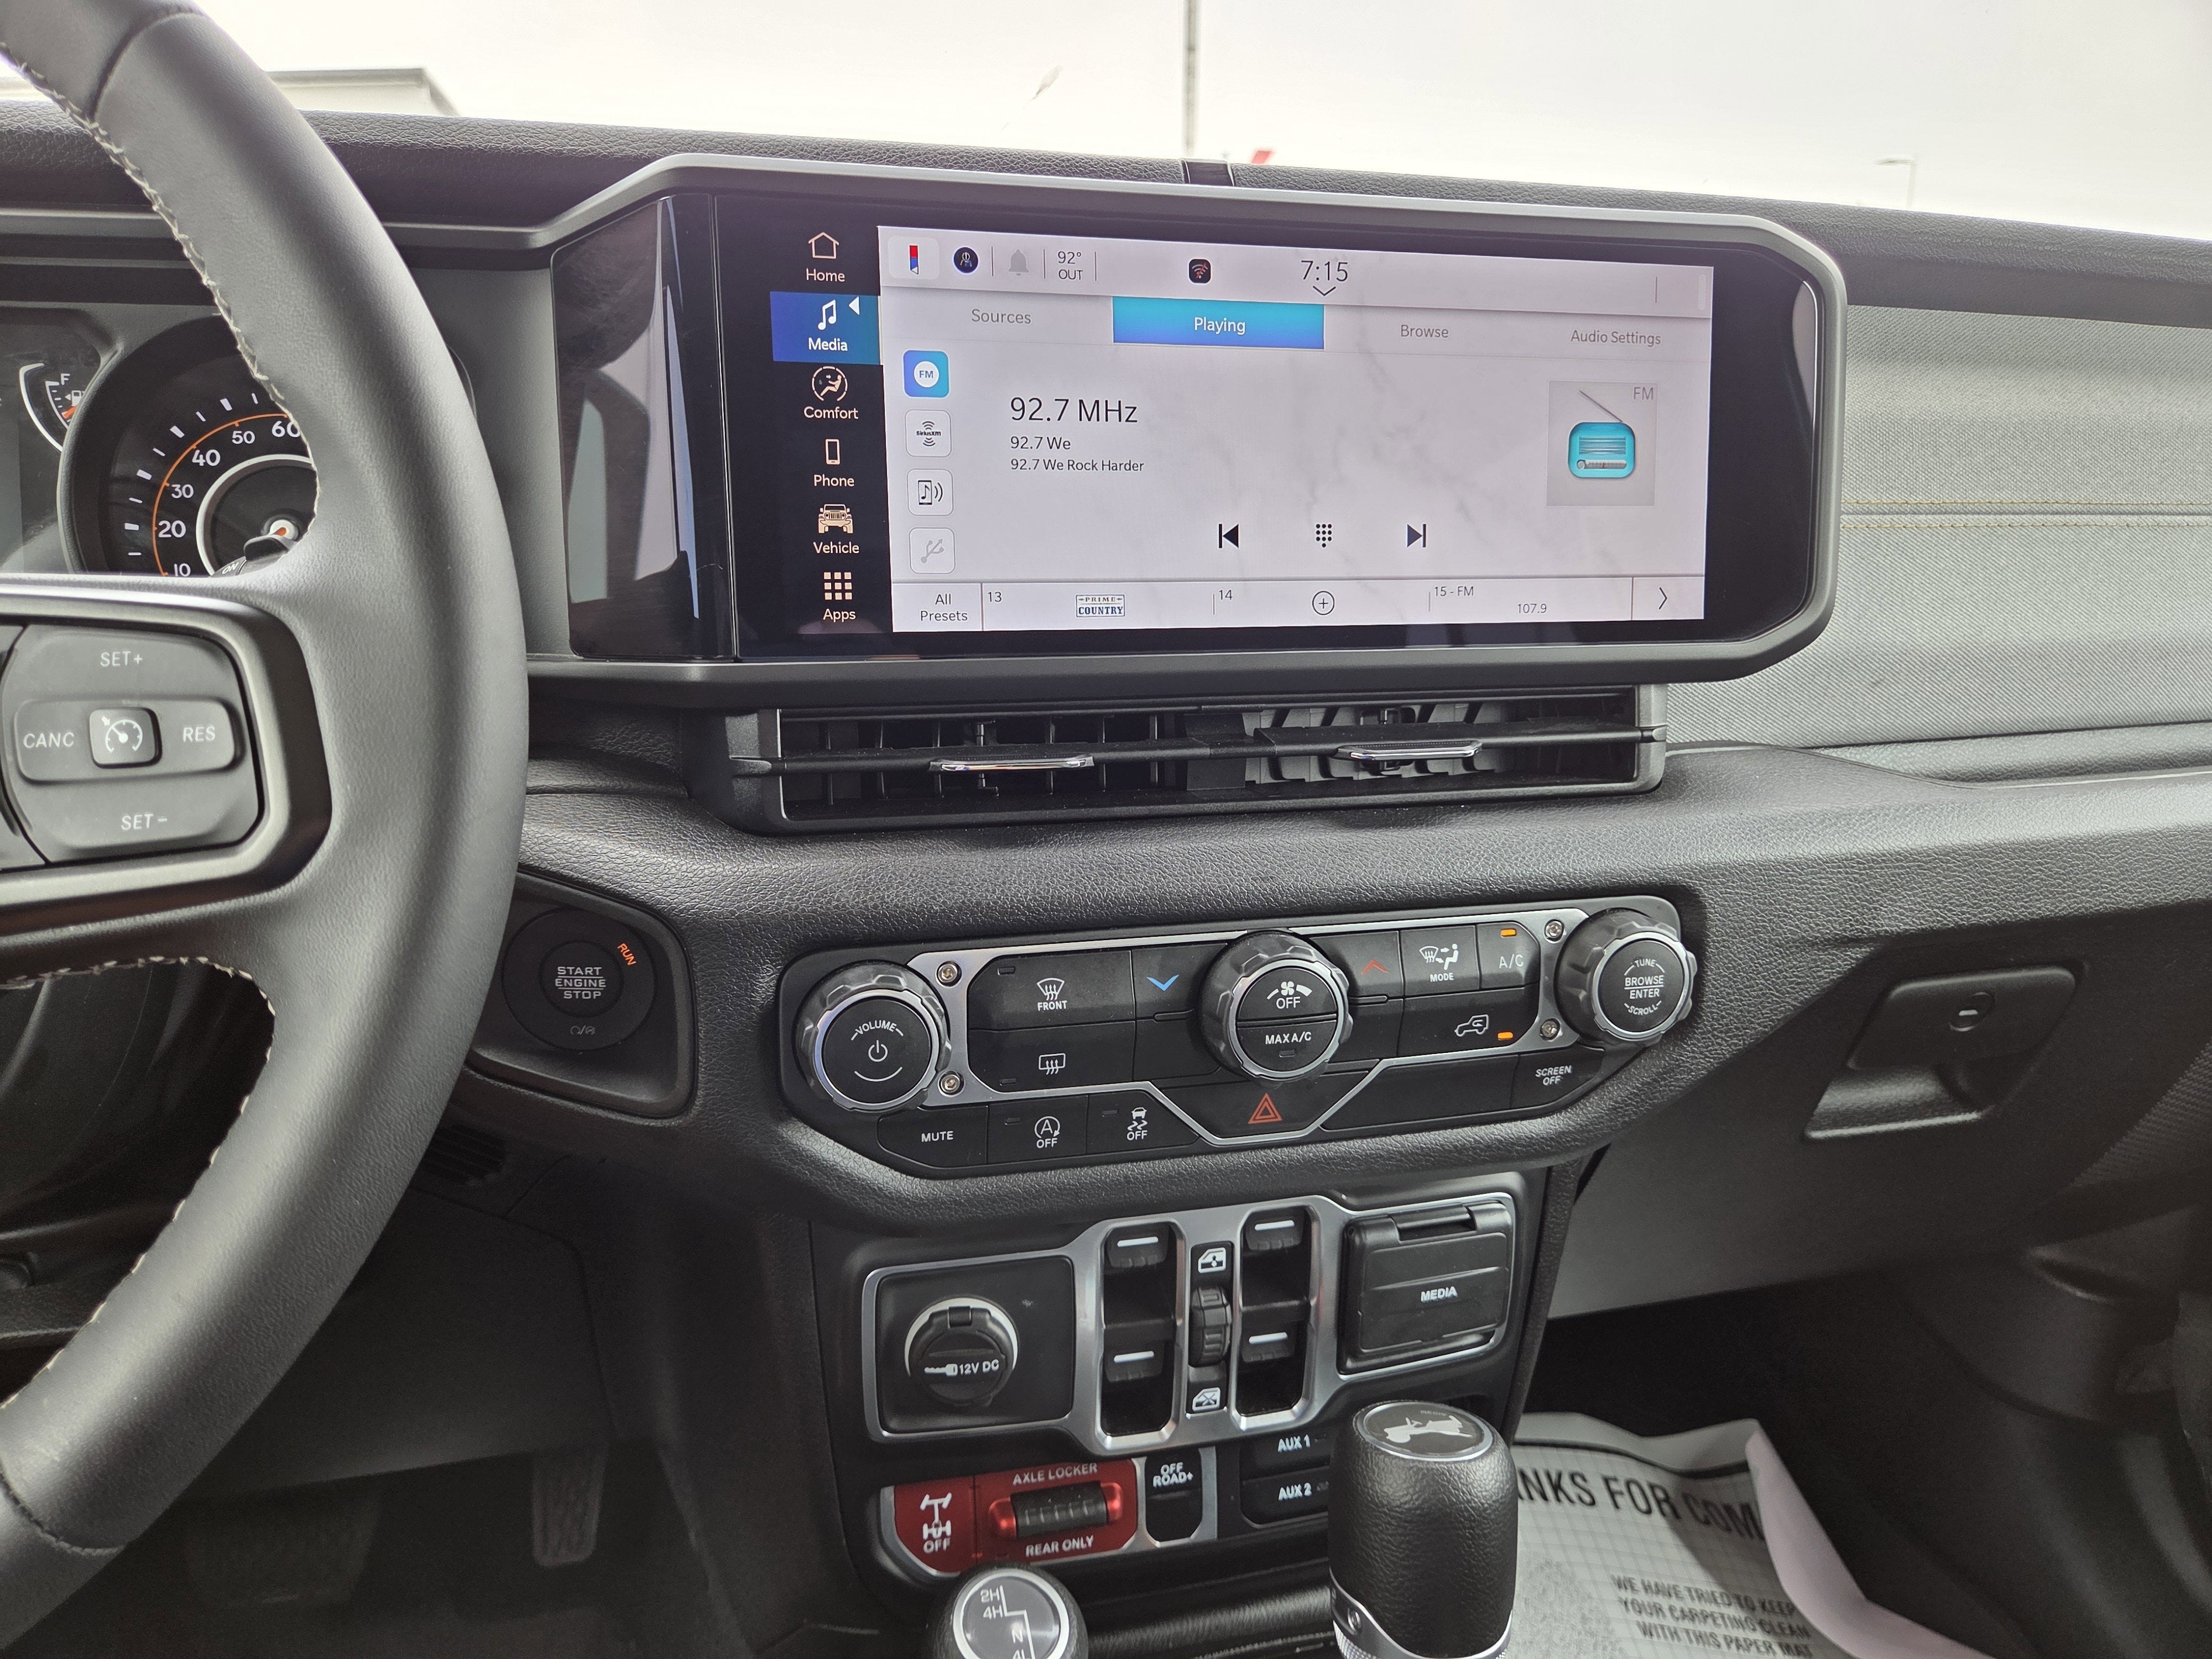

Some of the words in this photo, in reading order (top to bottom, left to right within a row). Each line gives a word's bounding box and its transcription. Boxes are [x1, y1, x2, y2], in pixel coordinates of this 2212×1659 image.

[806, 268, 846, 282] Home
[1058, 269, 1083, 281] OUT
[1301, 260, 1349, 283] 7:15
[971, 309, 1031, 324] Sources
[1193, 317, 1246, 335] Playing
[1400, 324, 1449, 339] Browse
[808, 337, 848, 352] Media
[1571, 330, 1608, 344] Audio
[1610, 331, 1662, 347] Settings
[61, 373, 70, 385] F
[919, 370, 934, 379] FM
[1633, 387, 1653, 400] FM
[803, 406, 859, 420] Comfort
[1010, 397, 1070, 422] 92.7
[1078, 399, 1138, 423] MHz
[272, 421, 301, 437] 60
[232, 431, 255, 444] 50
[1010, 436, 1044, 450] 92.7
[1046, 437, 1071, 450] We
[192, 449, 221, 466] 40
[1010, 458, 1040, 471] 92.7
[1043, 459, 1065, 471] We
[1067, 458, 1098, 471] Rock
[1101, 459, 1145, 472] Harder
[813, 474, 855, 487] Phone
[171, 484, 194, 499] 30
[158, 520, 186, 538] 20
[813, 541, 860, 554] Vehicle
[174, 563, 191, 577] 10
[935, 593, 952, 605] All
[987, 591, 1002, 603] 13
[1219, 590, 1233, 601] 14
[1434, 587, 1446, 597] 15
[1457, 586, 1474, 598] FM
[920, 609, 968, 622] Presets
[1078, 605, 1124, 615] COUNTRY
[1517, 603, 1547, 614] 107.9
[823, 609, 856, 623] Apps
[23, 732, 75, 749] CANC
[182, 726, 216, 742] RES
[617, 943, 636, 966] RUN
[1499, 954, 1525, 969] A/C
[1634, 958, 1656, 968] TUNE
[557, 966, 602, 975] START
[1430, 972, 1454, 983] MODE
[555, 978, 606, 987] ENGINE
[1625, 975, 1664, 987] BROWSE
[563, 991, 601, 999] STOP
[1630, 988, 1660, 999] ENTER
[1037, 1000, 1067, 1011] FRONT
[1276, 996, 1301, 1009] OFF
[1627, 1004, 1658, 1015] SCROLL
[855, 1020, 898, 1036] VOLUME
[1265, 1032, 1289, 1045] MAX
[1291, 1031, 1312, 1044] A/C
[1535, 1065, 1572, 1078] SCREEN
[1542, 1075, 1561, 1086] OFF
[921, 1130, 954, 1143] MUTE
[1126, 1128, 1148, 1141] OFF
[1036, 1138, 1058, 1149] OFF
[1421, 1286, 1458, 1302] MEDIA
[959, 1362, 979, 1375] 12V
[983, 1359, 999, 1372] DC
[1278, 1436, 1302, 1453] AUX
[1304, 1434, 1311, 1448] 1
[1013, 1469, 1045, 1485] AXLE
[1048, 1463, 1098, 1480] LOCKER
[1161, 1462, 1183, 1474] OFF
[1279, 1484, 1302, 1501] AUX
[1304, 1482, 1312, 1496] 2
[1517, 1468, 1596, 1507] NKS
[1601, 1475, 1682, 1520] FOR
[923, 1538, 950, 1554] OFF
[1025, 1540, 1059, 1558] REAR
[1062, 1535, 1094, 1553] ONLY
[980, 1587, 1000, 1603] 2H
[1610, 1574, 1640, 1594] WE
[1641, 1578, 1686, 1601] HAVE
[1684, 1585, 1733, 1608] TRIED
[983, 1604, 1003, 1619] 4H
[1617, 1595, 1667, 1620] YOUR
[1667, 1603, 1757, 1632] CARPETING
[1757, 1616, 1812, 1640] CLEAN
[1636, 1620, 1682, 1642] WITH
[1683, 1627, 1721, 1650] THIS
[1722, 1634, 1778, 1657] PAPER
